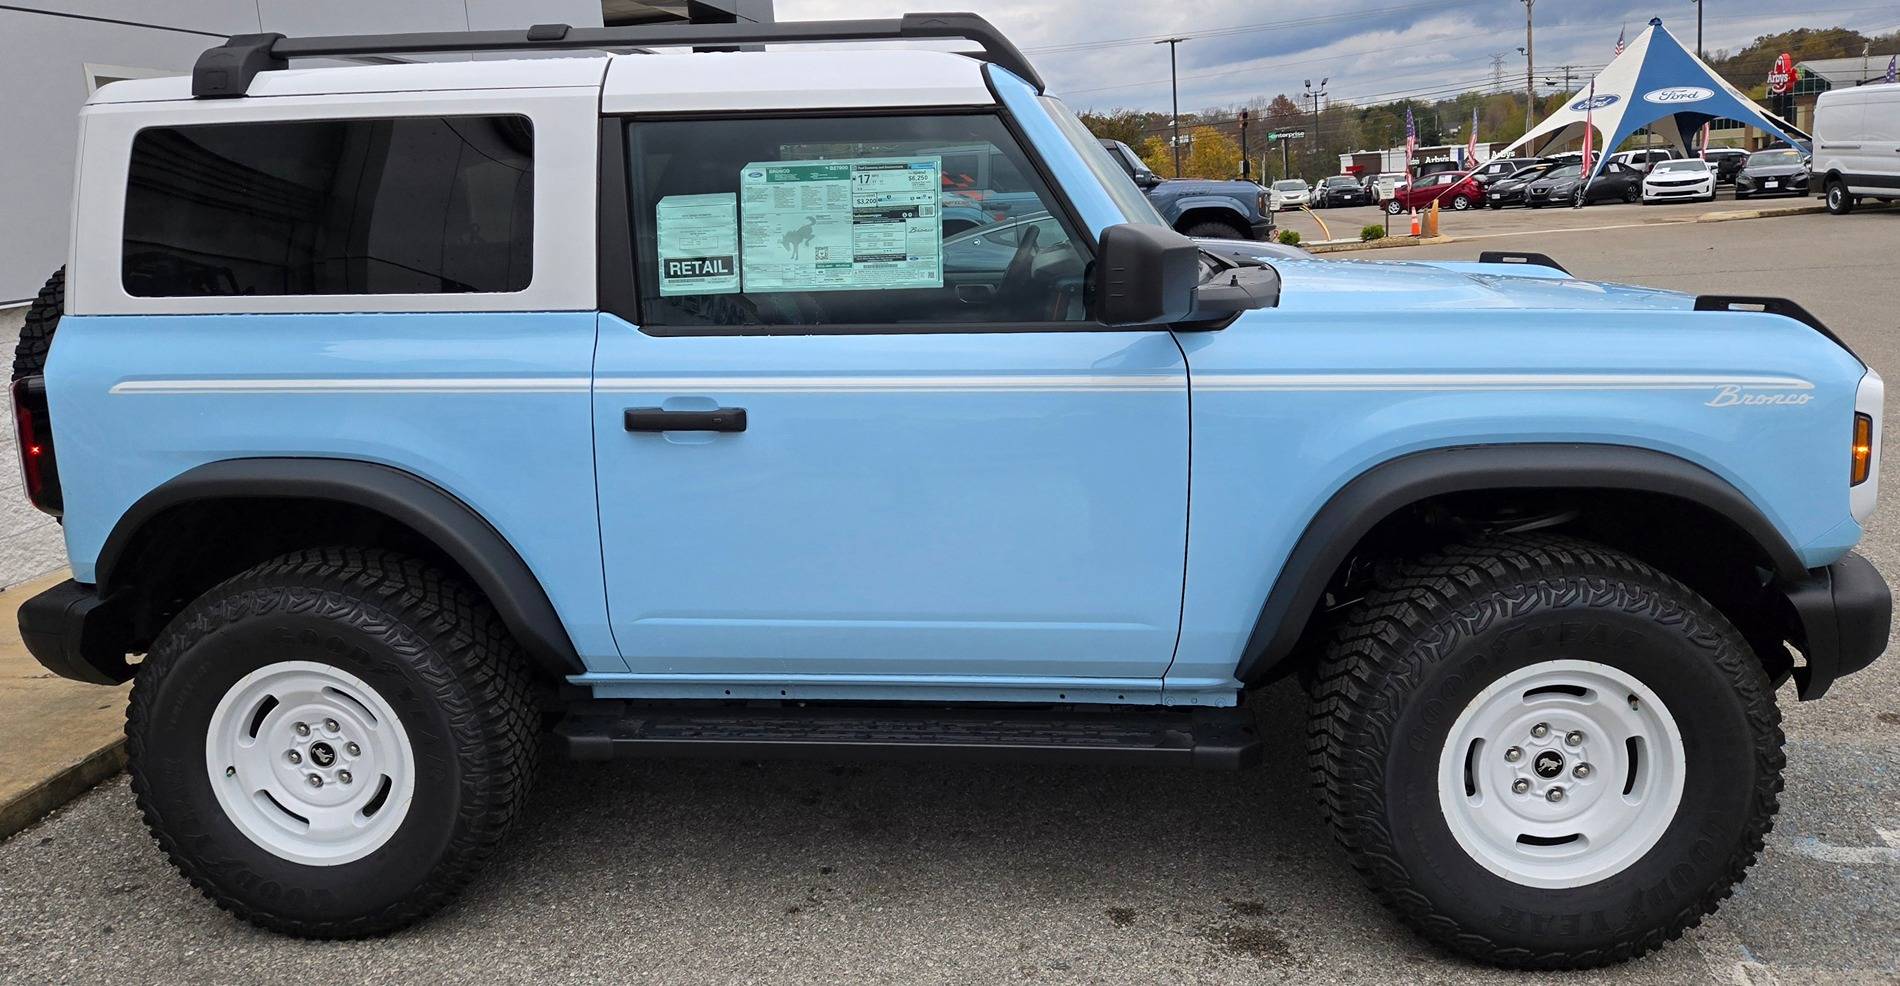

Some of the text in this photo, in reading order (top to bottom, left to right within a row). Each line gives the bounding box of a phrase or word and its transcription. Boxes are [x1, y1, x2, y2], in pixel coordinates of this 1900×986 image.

[1659, 89, 1698, 101] Ford
[1578, 97, 1612, 109] Ford
[1268, 131, 1305, 140] enterprise
[857, 174, 871, 184] 17
[669, 260, 729, 276] RETAIL
[1704, 384, 1815, 408] Bronco
